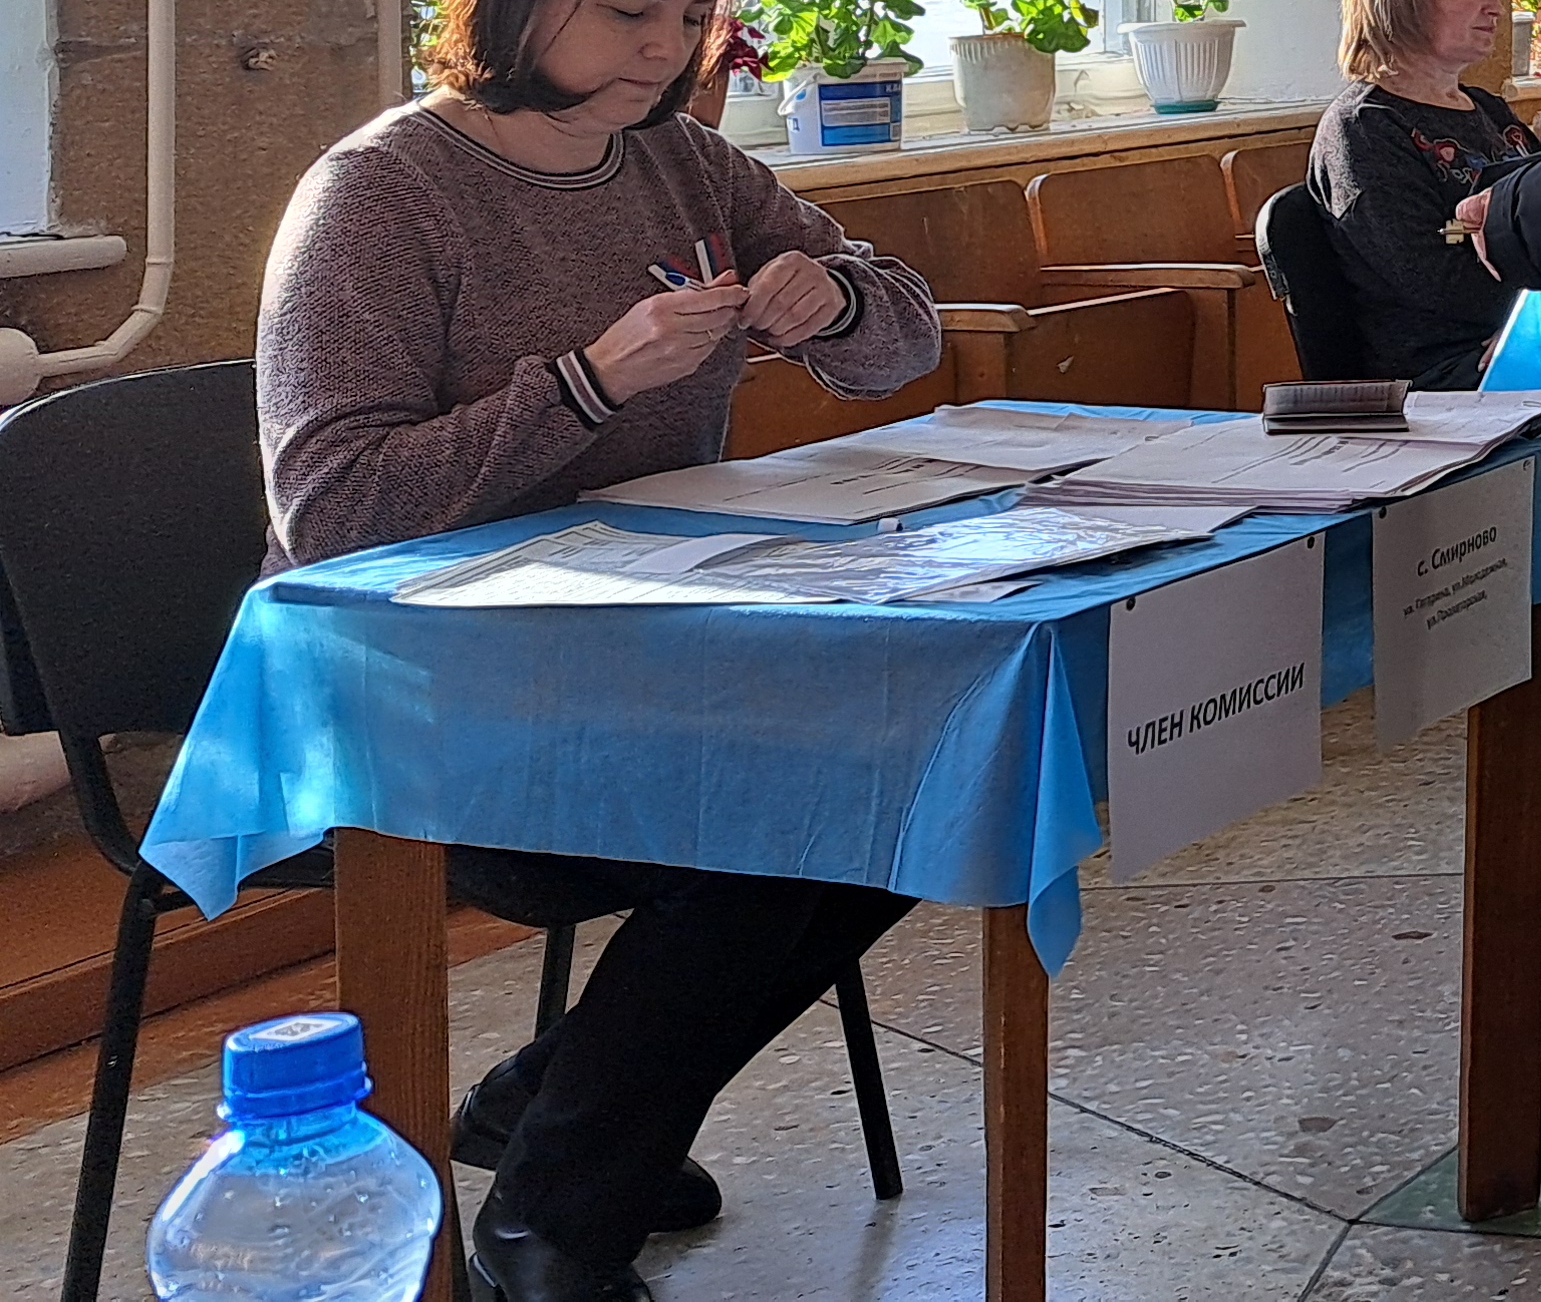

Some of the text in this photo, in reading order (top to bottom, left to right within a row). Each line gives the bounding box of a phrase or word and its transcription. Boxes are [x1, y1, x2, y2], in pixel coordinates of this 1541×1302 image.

[1417, 526, 1497, 577] с. Смирново
[1128, 662, 1305, 755] ЧЛЕН КОМИССИИ
